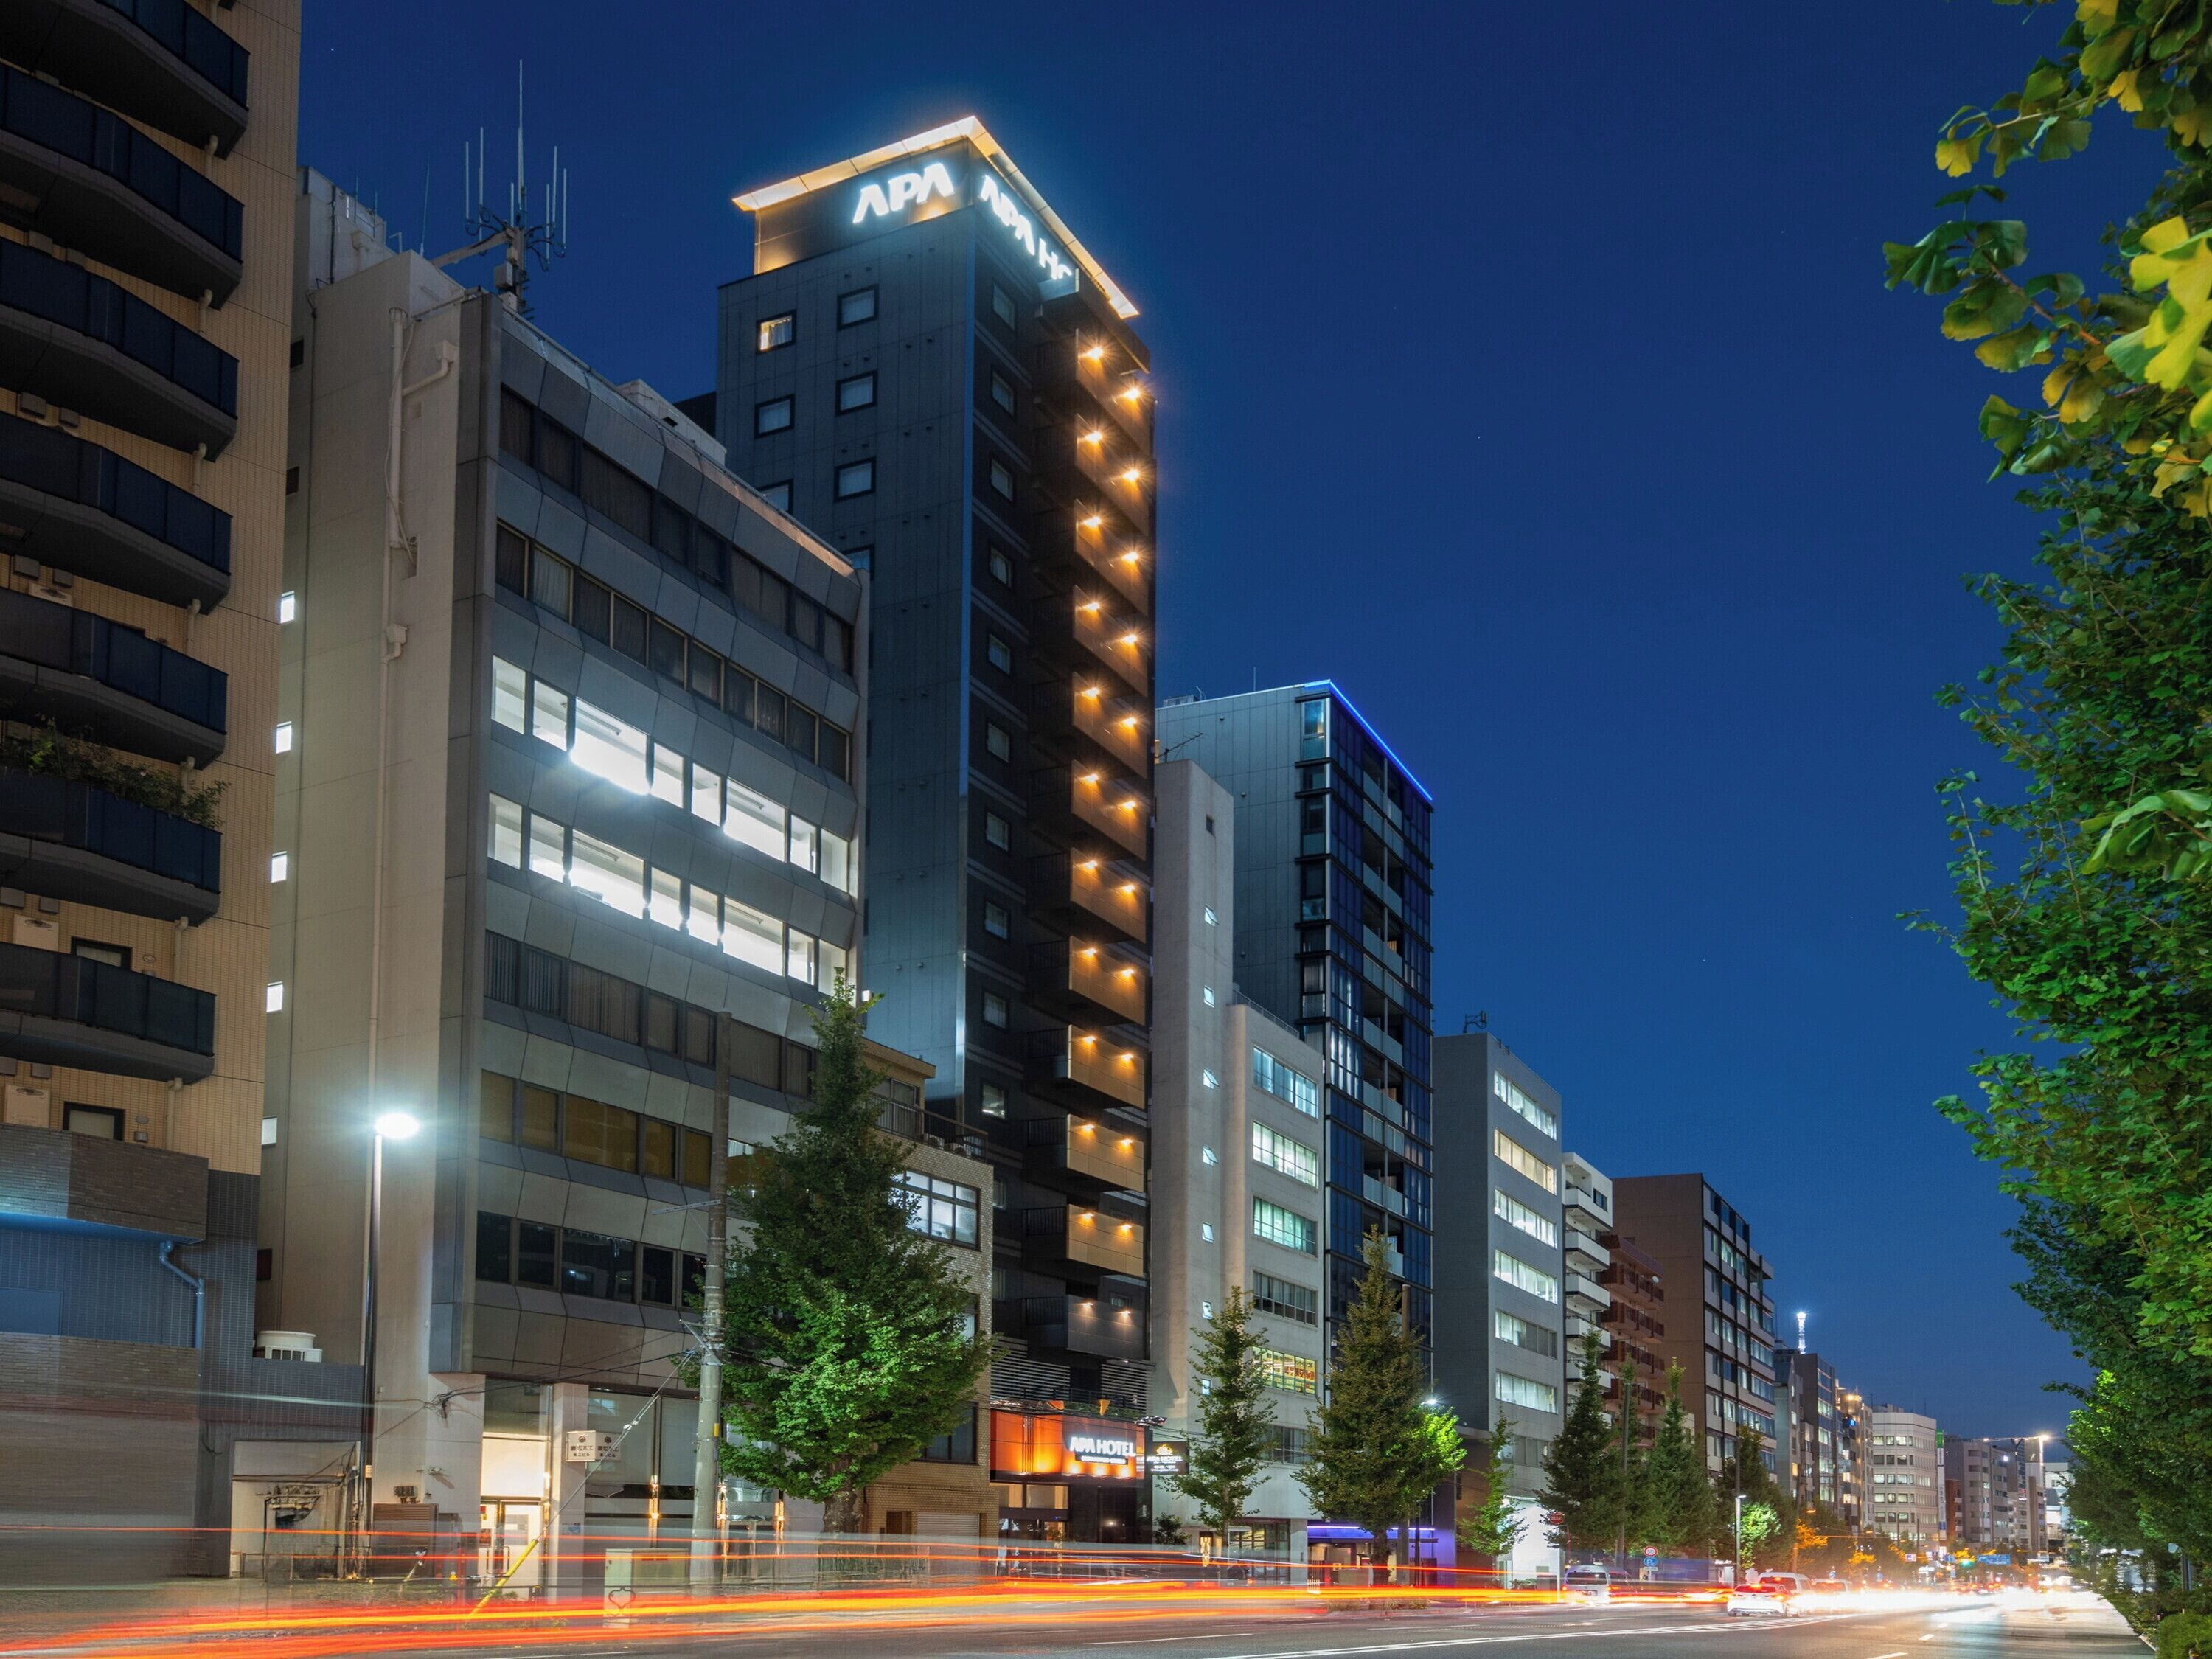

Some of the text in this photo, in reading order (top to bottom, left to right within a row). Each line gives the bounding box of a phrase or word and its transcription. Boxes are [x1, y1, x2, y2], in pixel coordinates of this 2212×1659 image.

[852, 162, 956, 224] APA
[980, 174, 1035, 256] APA
[1069, 1436, 1136, 1457] APA HOTEL
